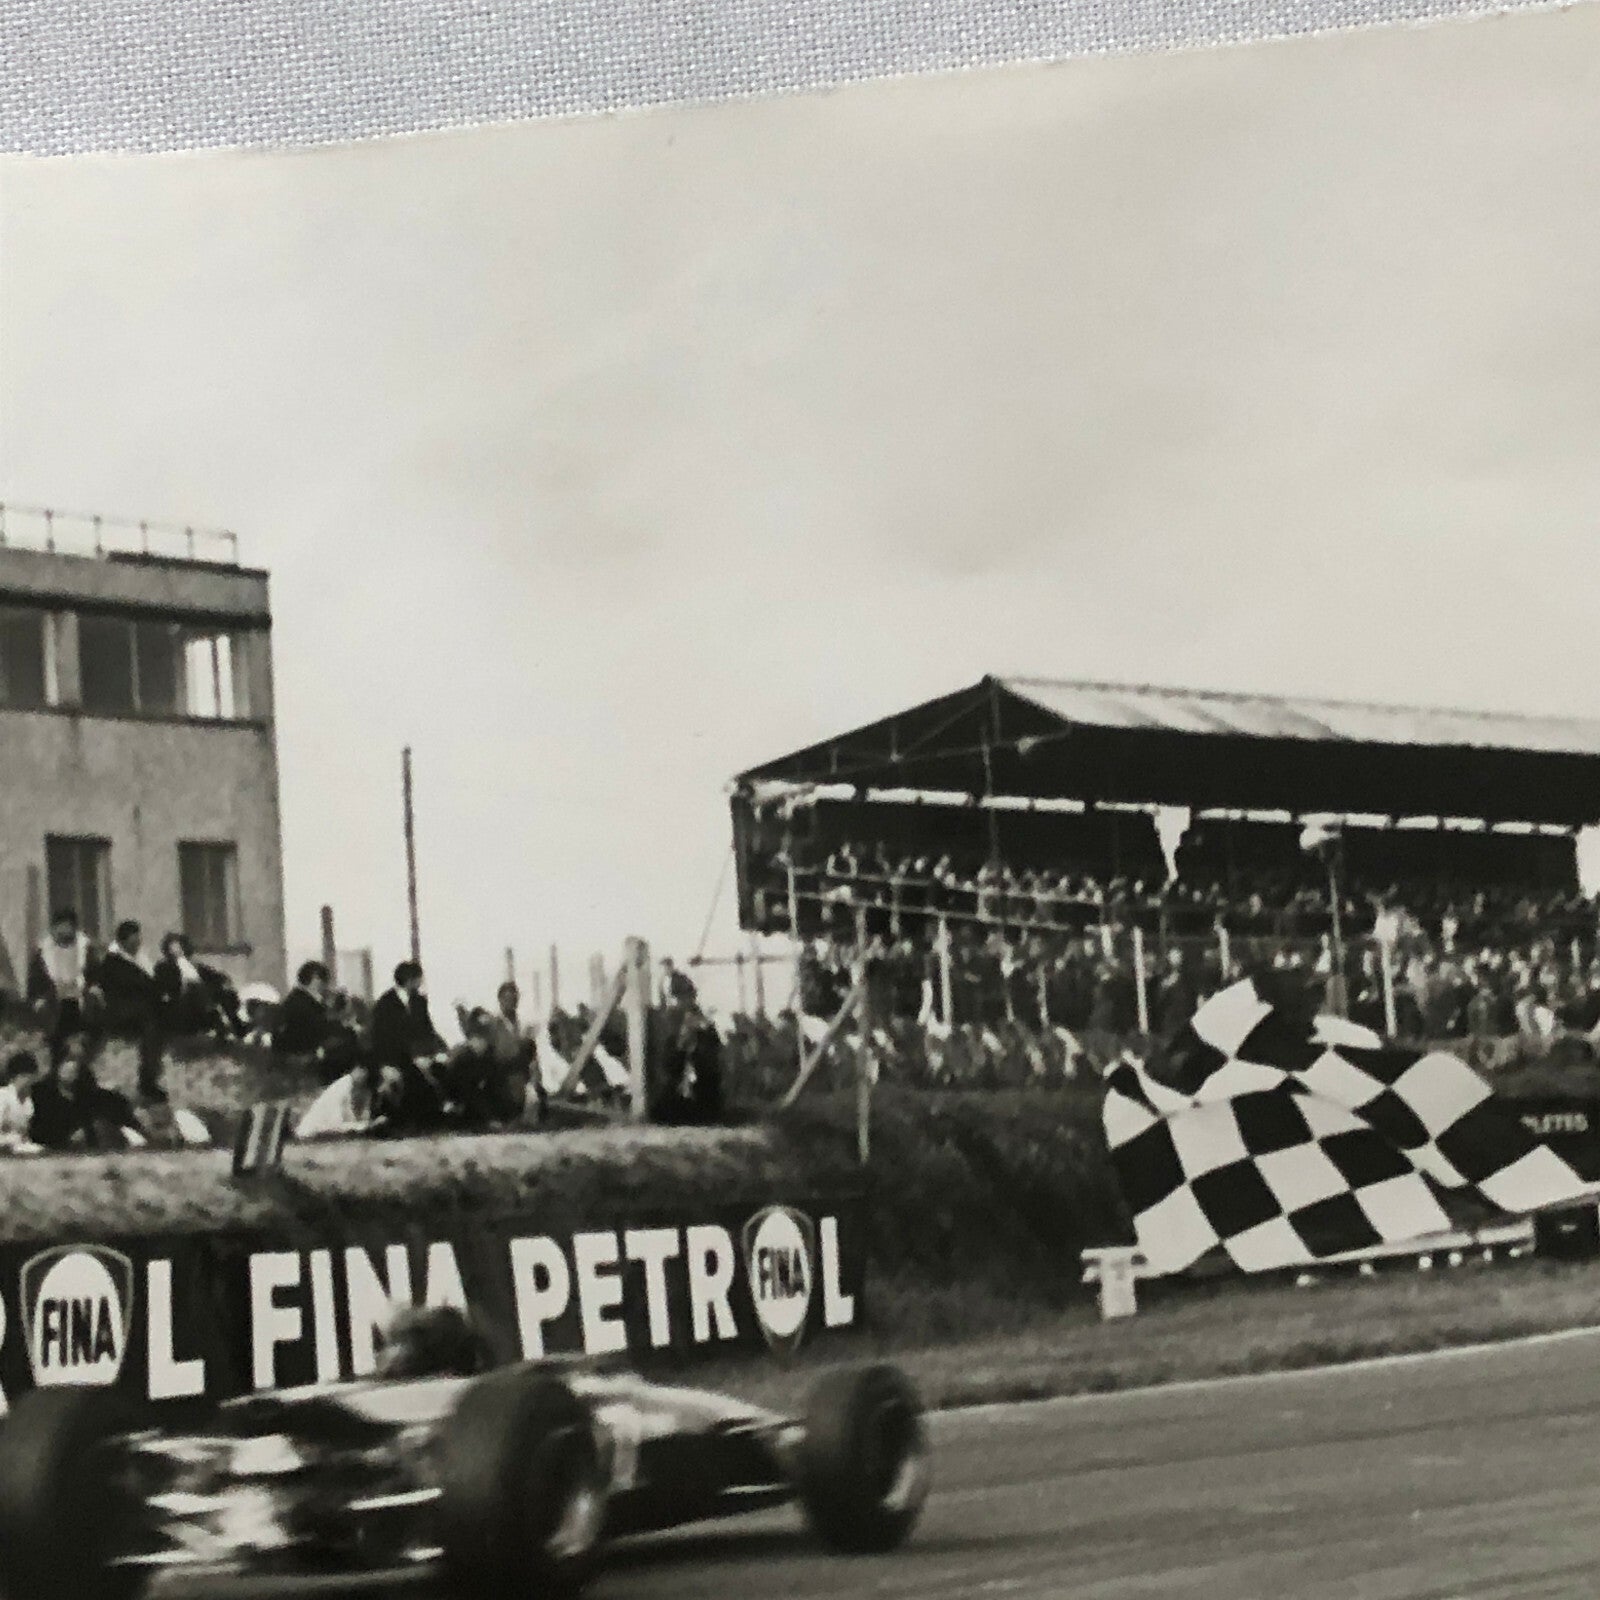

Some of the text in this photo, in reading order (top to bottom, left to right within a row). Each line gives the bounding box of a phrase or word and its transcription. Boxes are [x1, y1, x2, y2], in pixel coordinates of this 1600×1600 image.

[249, 1241, 469, 1389] FINA
[509, 1206, 854, 1361] PETROL
[757, 1246, 806, 1301] FINA
[41, 1296, 117, 1369] FINA
